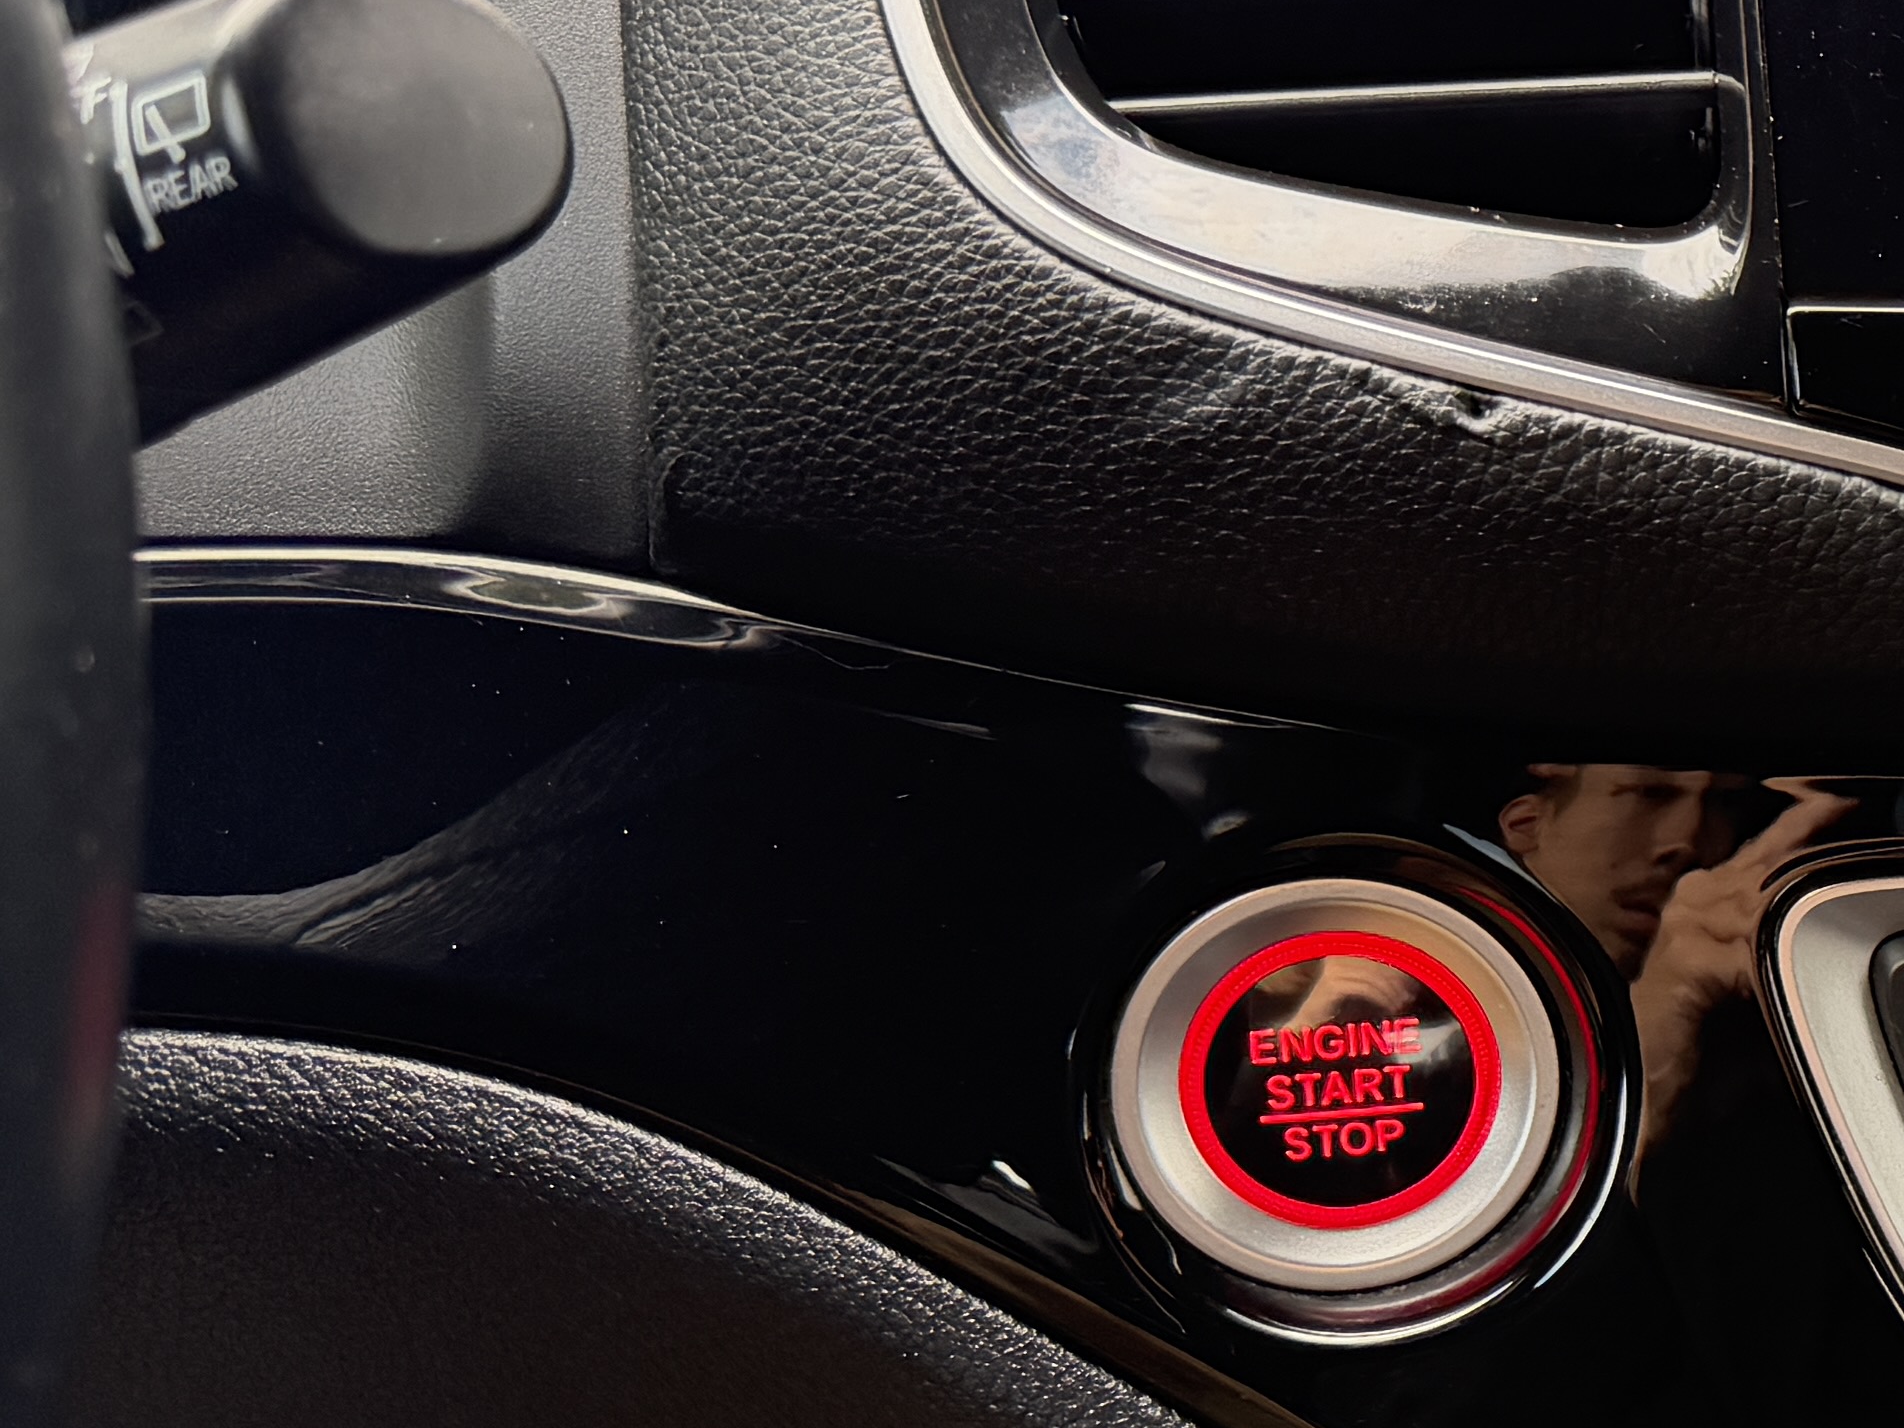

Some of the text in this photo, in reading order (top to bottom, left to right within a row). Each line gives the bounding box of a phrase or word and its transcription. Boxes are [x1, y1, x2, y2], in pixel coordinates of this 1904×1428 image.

[145, 155, 239, 214] REAR
[1248, 1016, 1422, 1067] ENGINE
[1264, 1063, 1412, 1113] START
[1284, 1119, 1406, 1163] STOP
